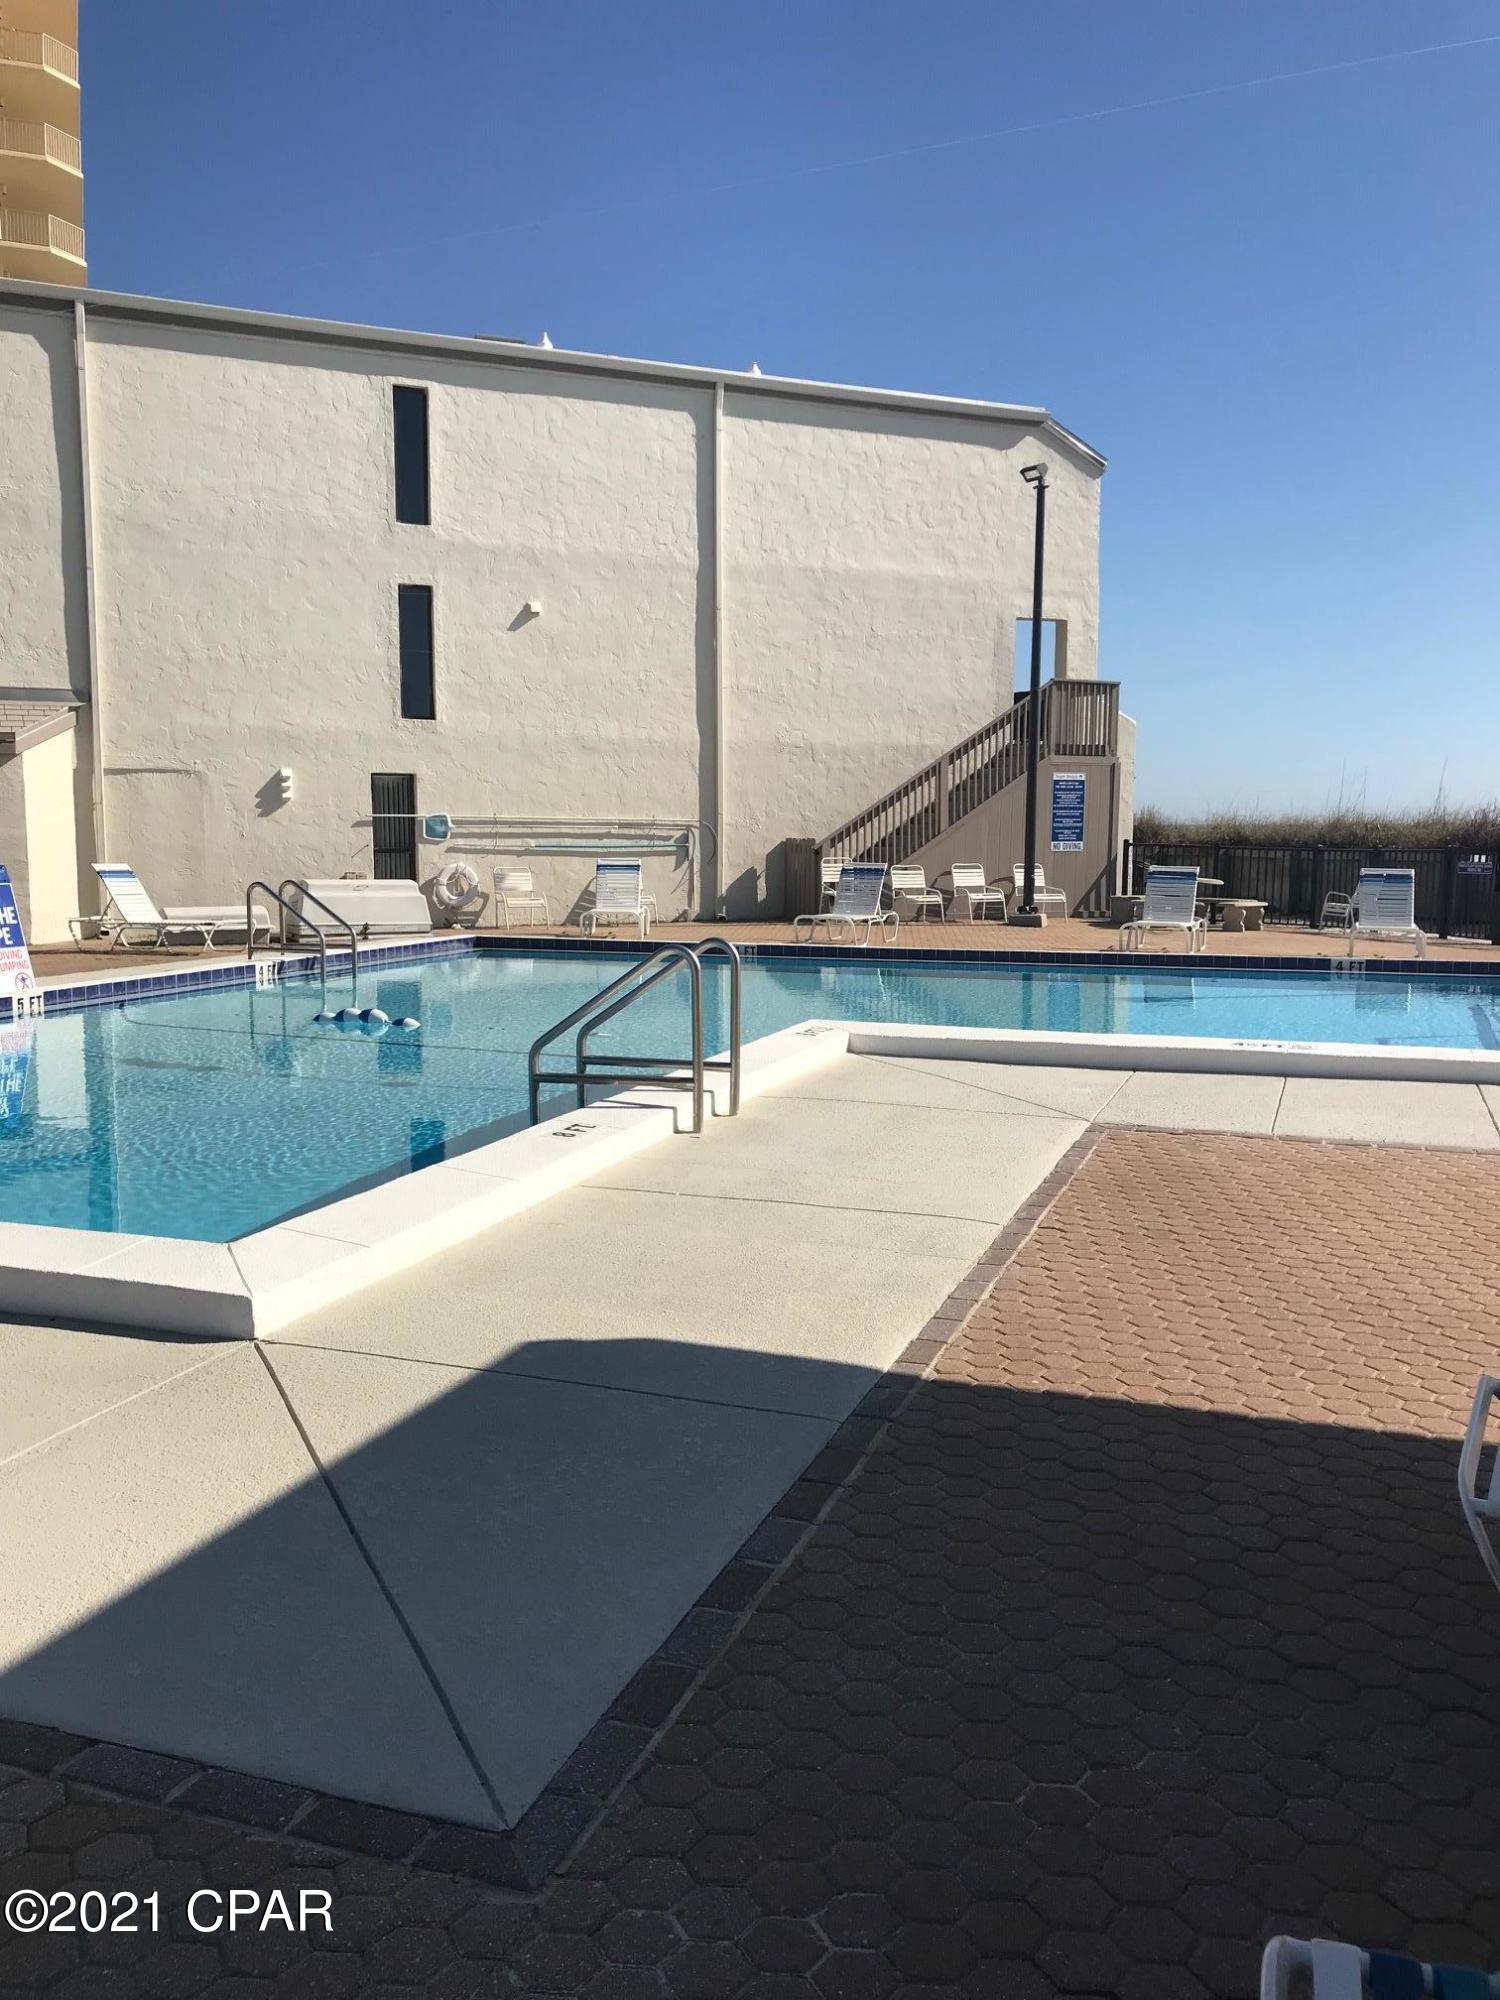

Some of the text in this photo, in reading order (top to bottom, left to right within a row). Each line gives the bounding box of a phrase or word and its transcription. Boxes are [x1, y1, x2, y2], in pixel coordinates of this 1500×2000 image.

[1053, 842, 1081, 850] NO DIVING
[1335, 961, 1364, 971] 4 FT
[18, 995, 42, 1010] 5 FT
